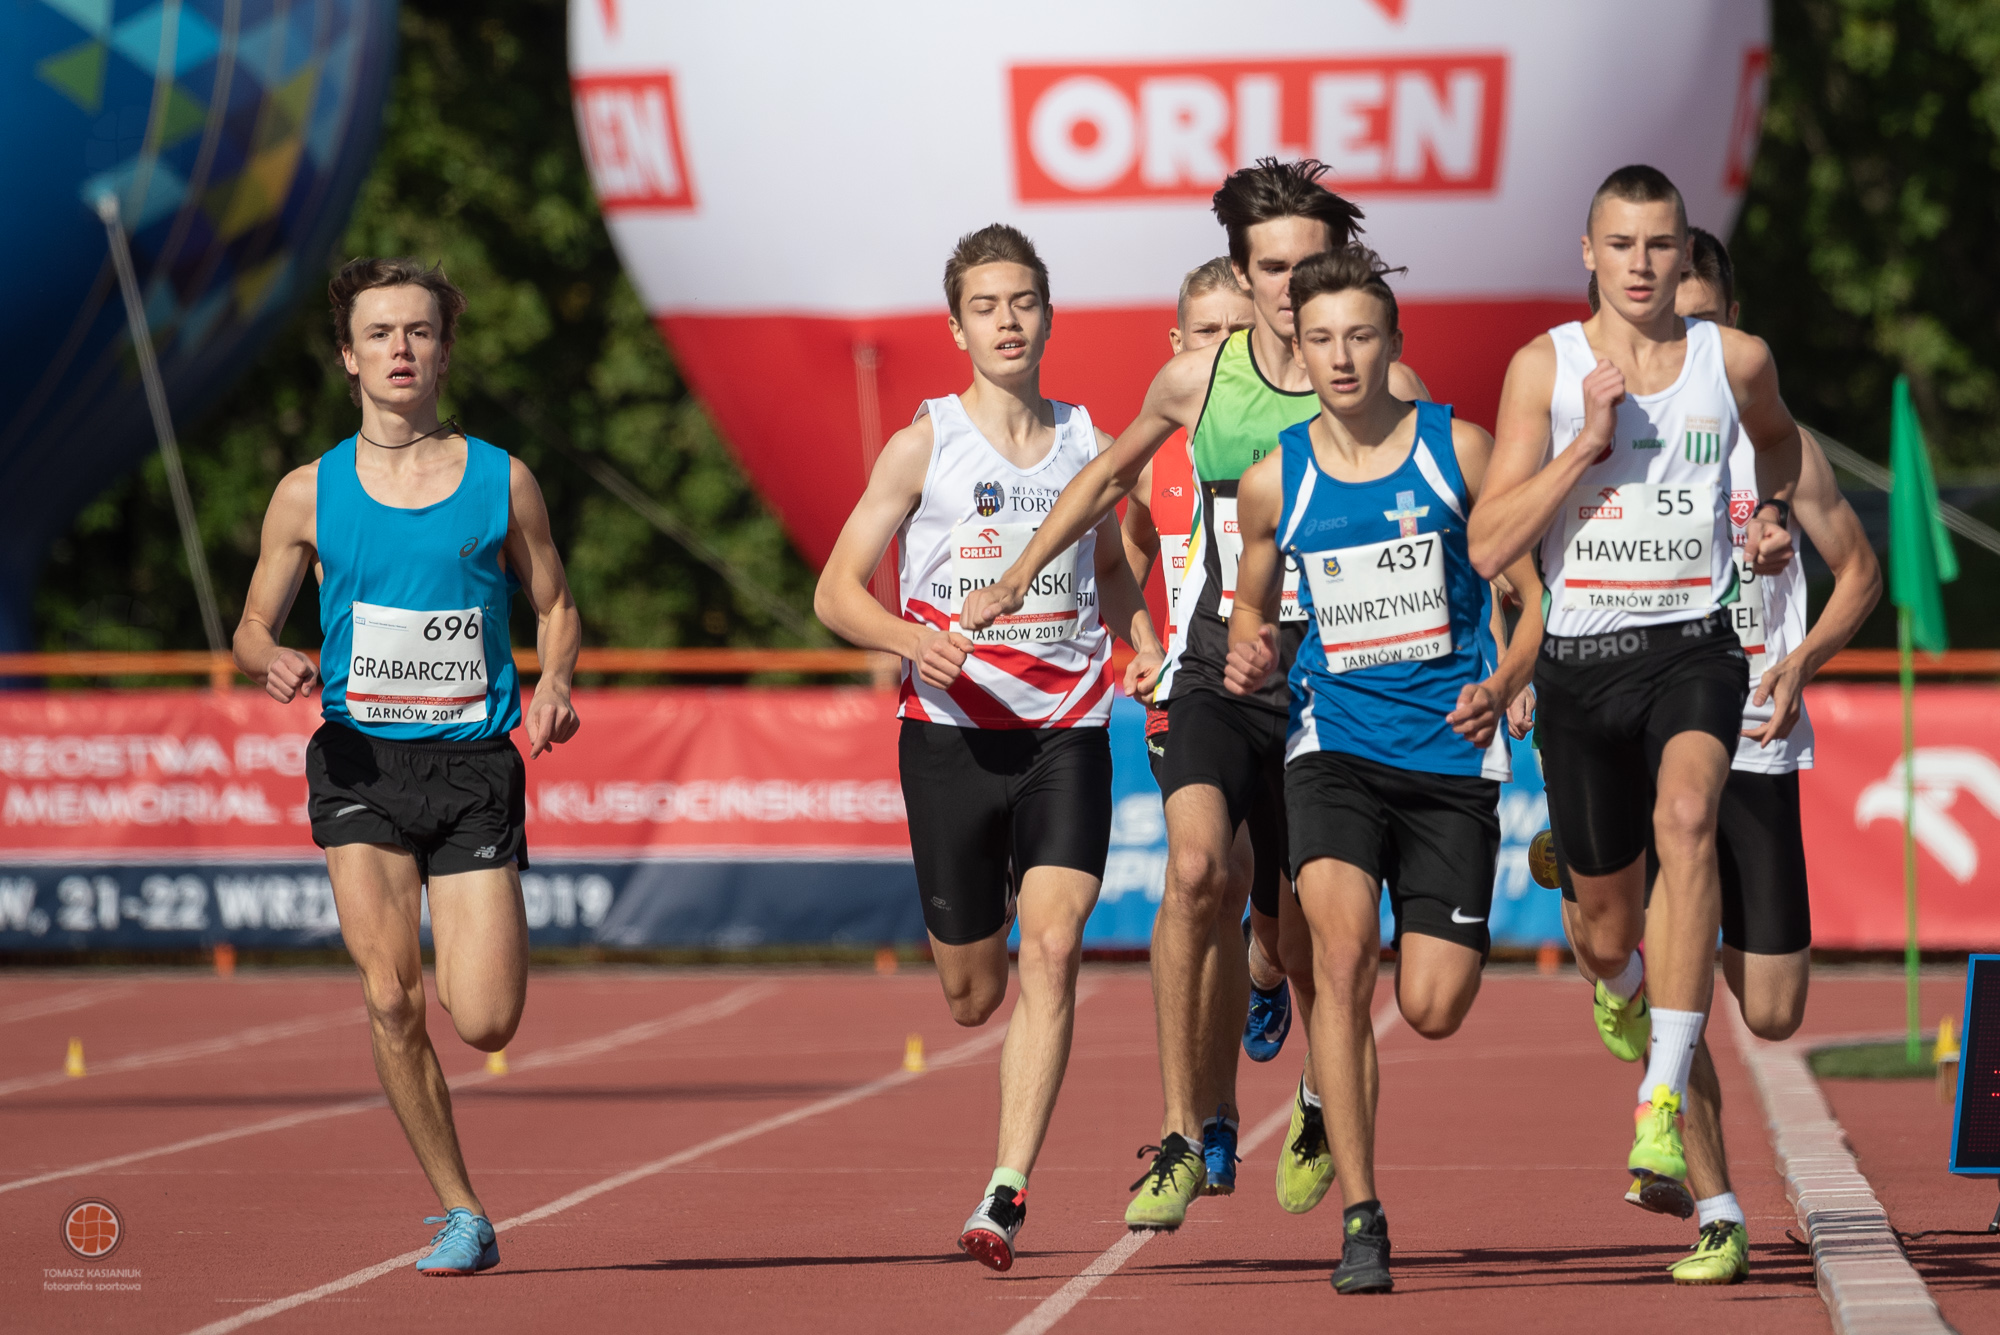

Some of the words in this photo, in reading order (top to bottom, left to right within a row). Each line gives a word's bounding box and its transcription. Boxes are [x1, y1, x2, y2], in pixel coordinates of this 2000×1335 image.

[1028, 68, 1486, 191] ORLEN
[1012, 486, 1060, 498] MIASTO
[1657, 489, 1694, 515] 55
[1010, 496, 1053, 513] TOR
[1579, 507, 1622, 519] ORLEN
[1317, 516, 1348, 532] asics
[961, 546, 1000, 558] ORLEN
[1376, 539, 1434, 573] 437
[1575, 538, 1703, 562] HAWEŁKO
[1077, 592, 1095, 607] RTU
[1315, 586, 1447, 628] WAWRZYNIAK
[1589, 592, 1653, 607] TARNÓW
[1657, 592, 1690, 607] 2019
[423, 613, 479, 641] 696
[1035, 625, 1064, 639] 2019
[1341, 648, 1402, 669] TARNÓW
[1407, 641, 1440, 659] 2019
[353, 655, 482, 681] GRABARCZYK
[366, 705, 428, 721] TARNÓW
[432, 708, 464, 722] 2019
[56, 874, 210, 931] 21-22
[213, 874, 341, 931] WRZ
[522, 873, 614, 930] 019
